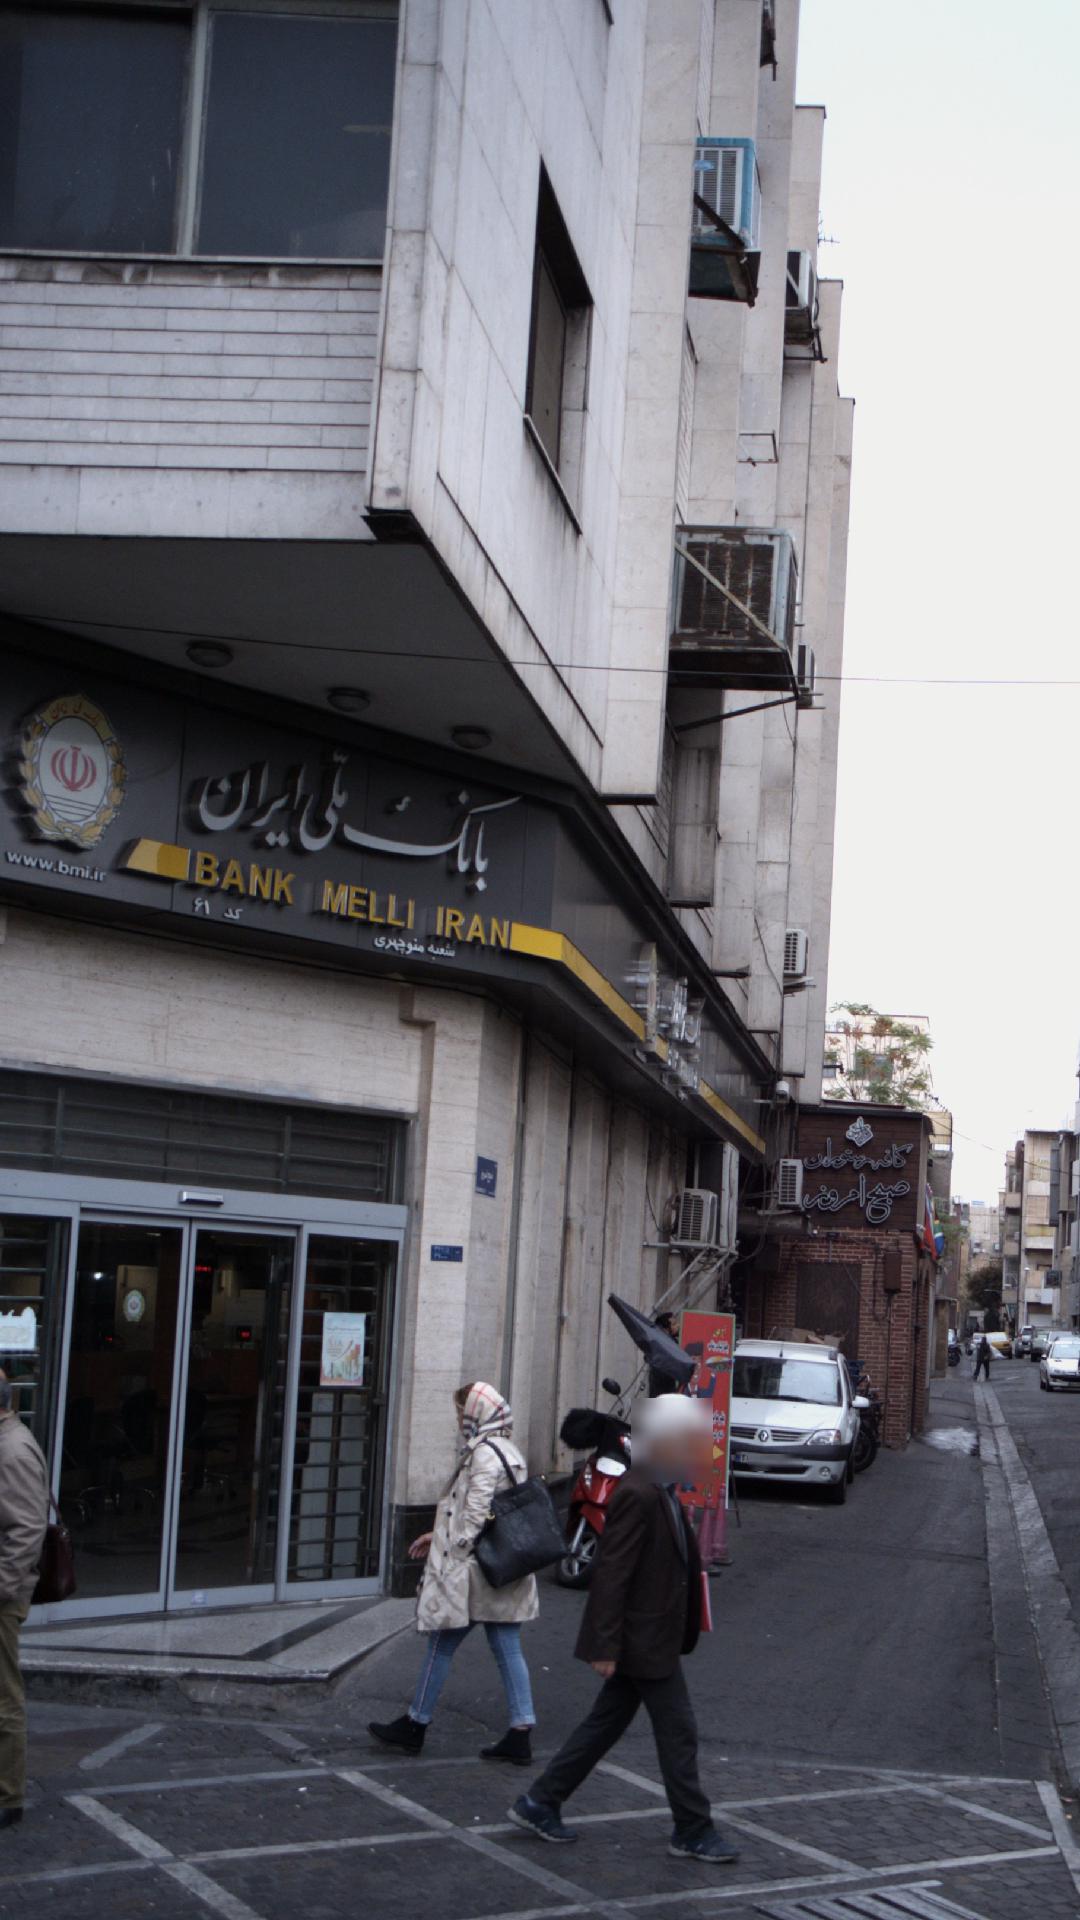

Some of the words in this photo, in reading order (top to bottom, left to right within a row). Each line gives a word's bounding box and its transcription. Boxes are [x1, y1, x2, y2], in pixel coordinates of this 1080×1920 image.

[198, 761, 306, 843] ایران
[6, 851, 107, 882] www.bmi.ir
[195, 851, 295, 906] BANK
[321, 879, 416, 930] MELLI
[435, 905, 510, 949] IRAN
[223, 907, 244, 920] کد
[373, 935, 425, 956] منوچهری
[426, 943, 456, 961] شعبه
[802, 1172, 866, 1212] امروز
[866, 1180, 911, 1224] صبح
